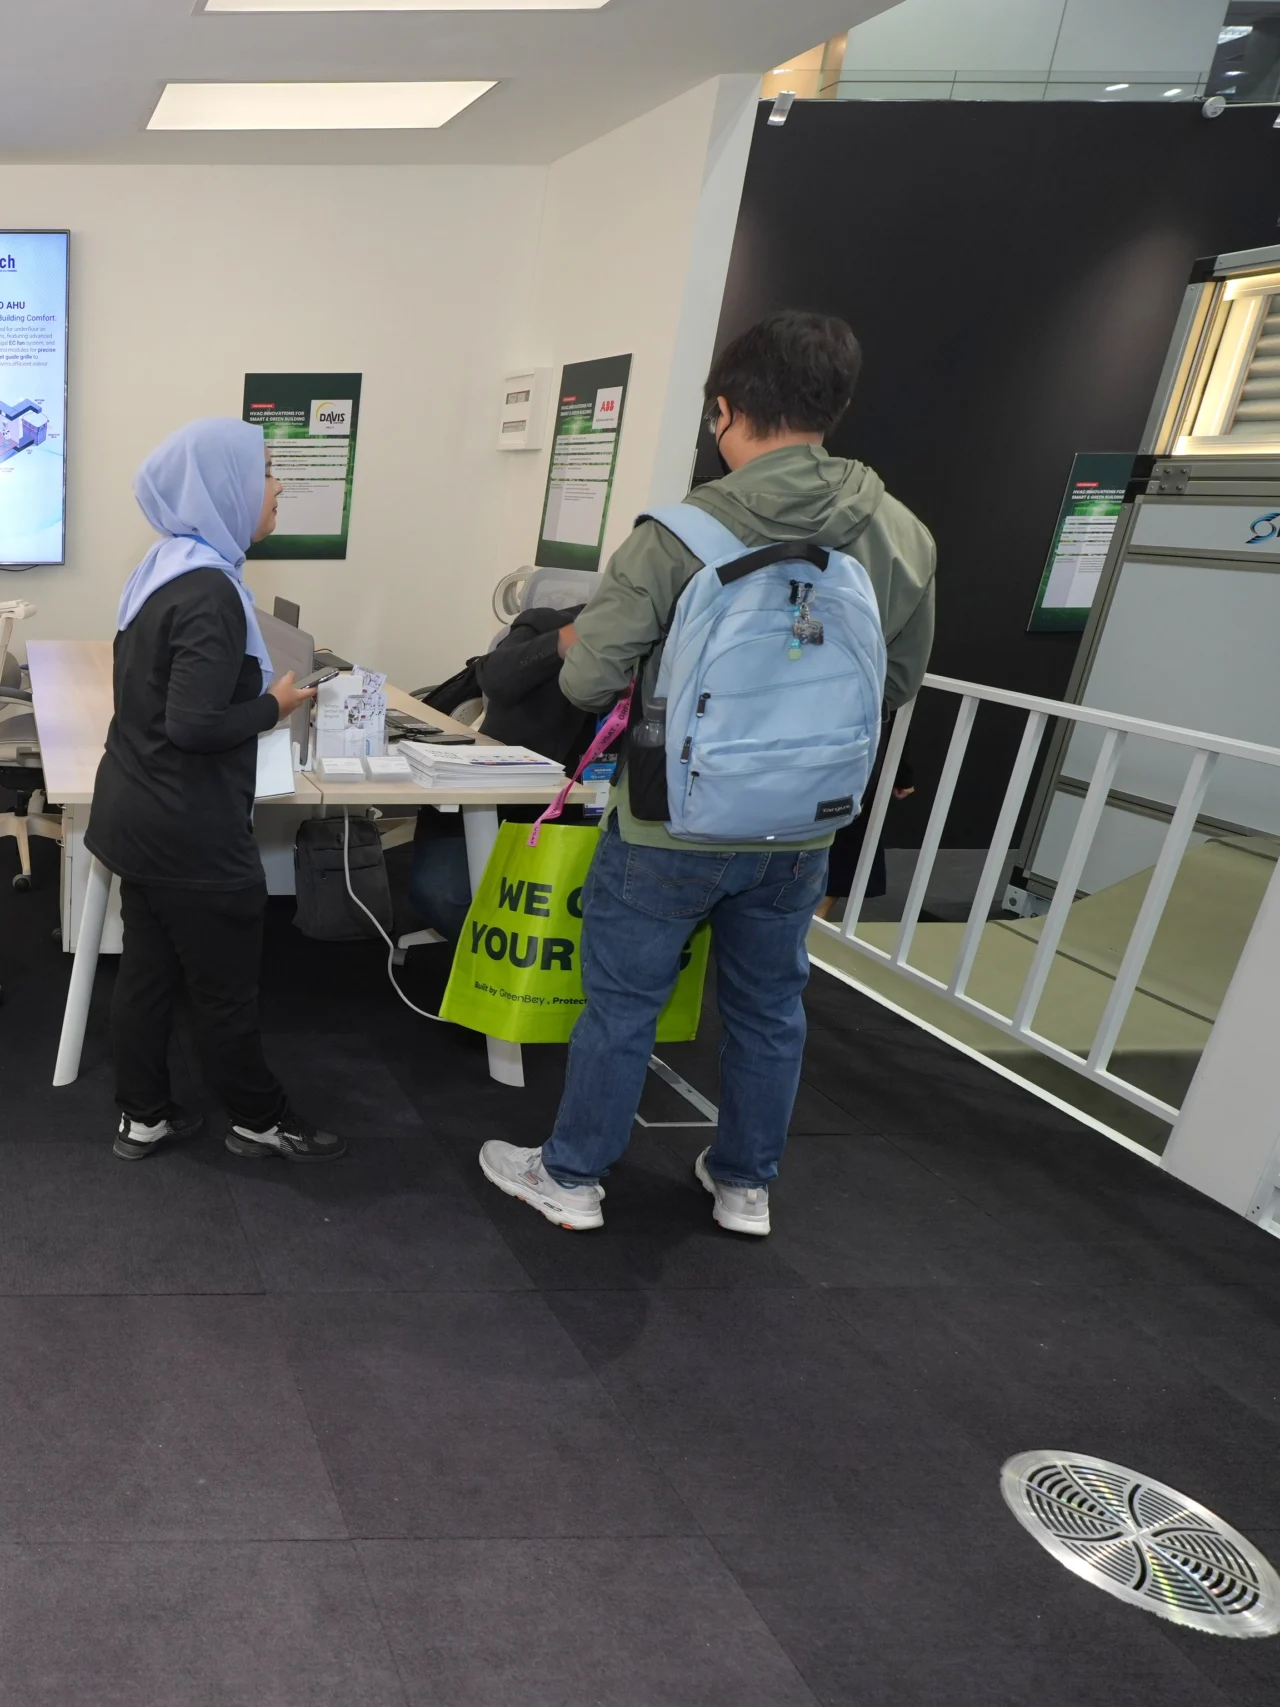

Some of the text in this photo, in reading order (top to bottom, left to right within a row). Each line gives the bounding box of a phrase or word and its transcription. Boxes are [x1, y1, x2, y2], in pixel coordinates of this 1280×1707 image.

[6, 301, 25, 310] AHU
[27, 314, 56, 322] Comfort.
[600, 401, 615, 412] ABB
[320, 411, 345, 424] DAVIS
[822, 803, 851, 814] Targus
[498, 876, 552, 918] WE
[471, 921, 575, 971] YOUR
[475, 981, 488, 992] Built
[489, 987, 498, 996] by
